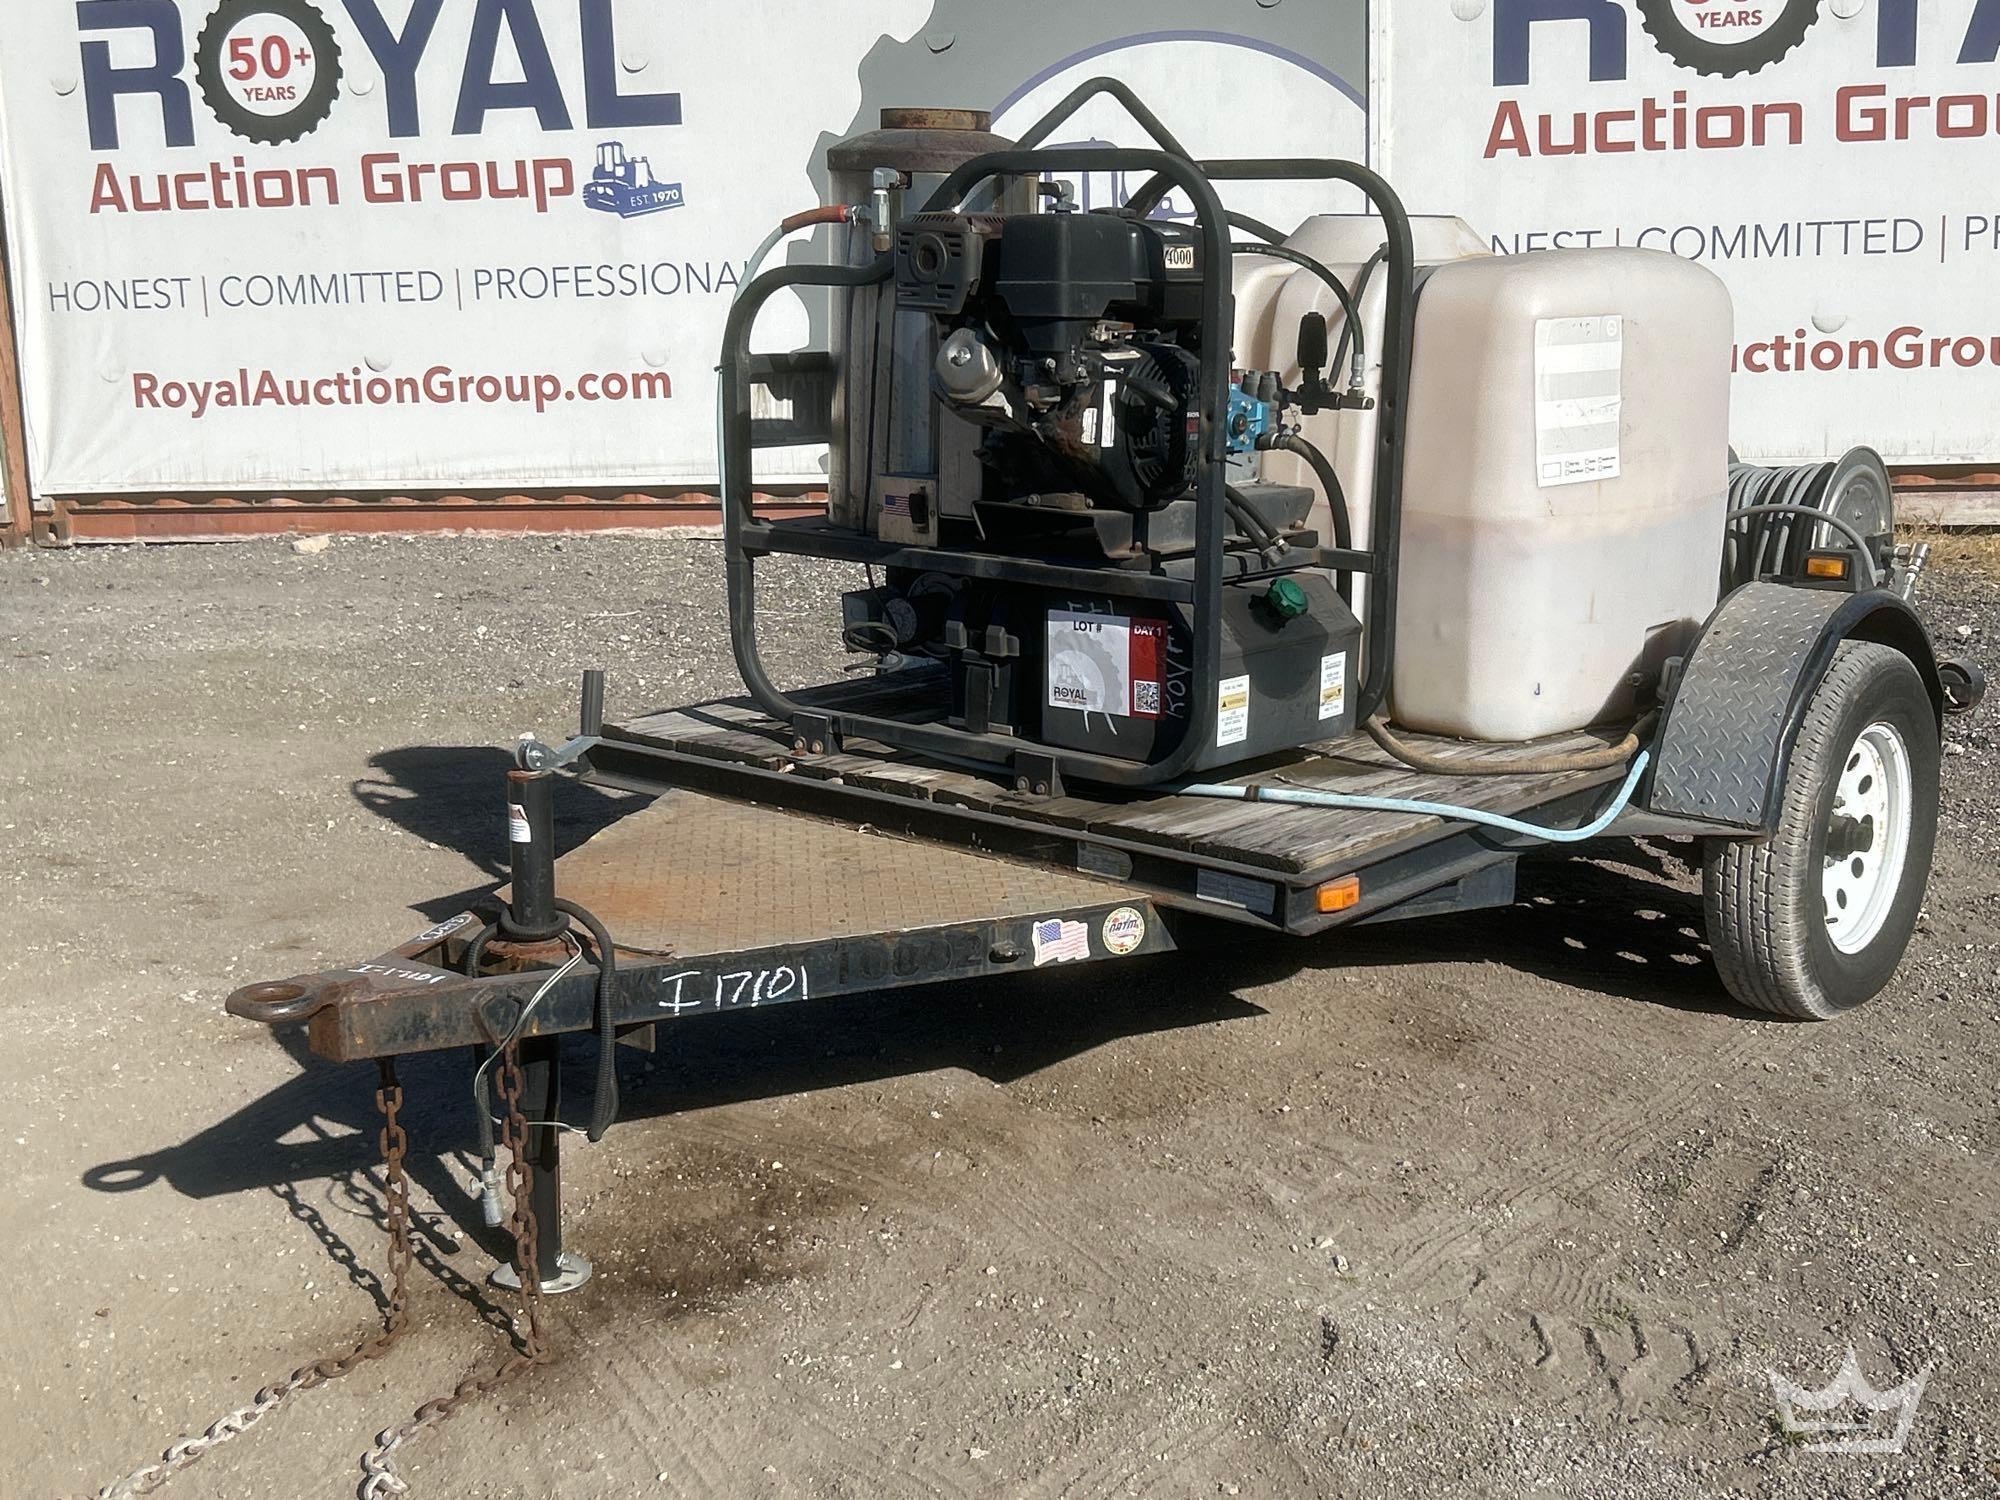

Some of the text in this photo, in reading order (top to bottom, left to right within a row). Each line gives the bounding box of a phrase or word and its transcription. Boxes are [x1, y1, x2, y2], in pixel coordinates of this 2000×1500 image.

[1696, 10, 1762, 28] YEARS
[76, 0, 683, 150] ROYAL
[229, 35, 311, 81] 50+
[243, 86, 296, 102] YEARS
[1483, 84, 2000, 159] Auction Gro
[90, 152, 574, 214] Auction Group
[653, 189, 680, 203] 1970
[1637, 217, 1924, 261] COMMITTED
[49, 261, 749, 312] HONEST COMMITTED PROFESSIONA
[133, 365, 672, 418] RoyalAuctionGroup.com
[1073, 620, 1094, 633] LOT
[1134, 625, 1154, 637] DAY
[1053, 686, 1088, 701] ROYAL
